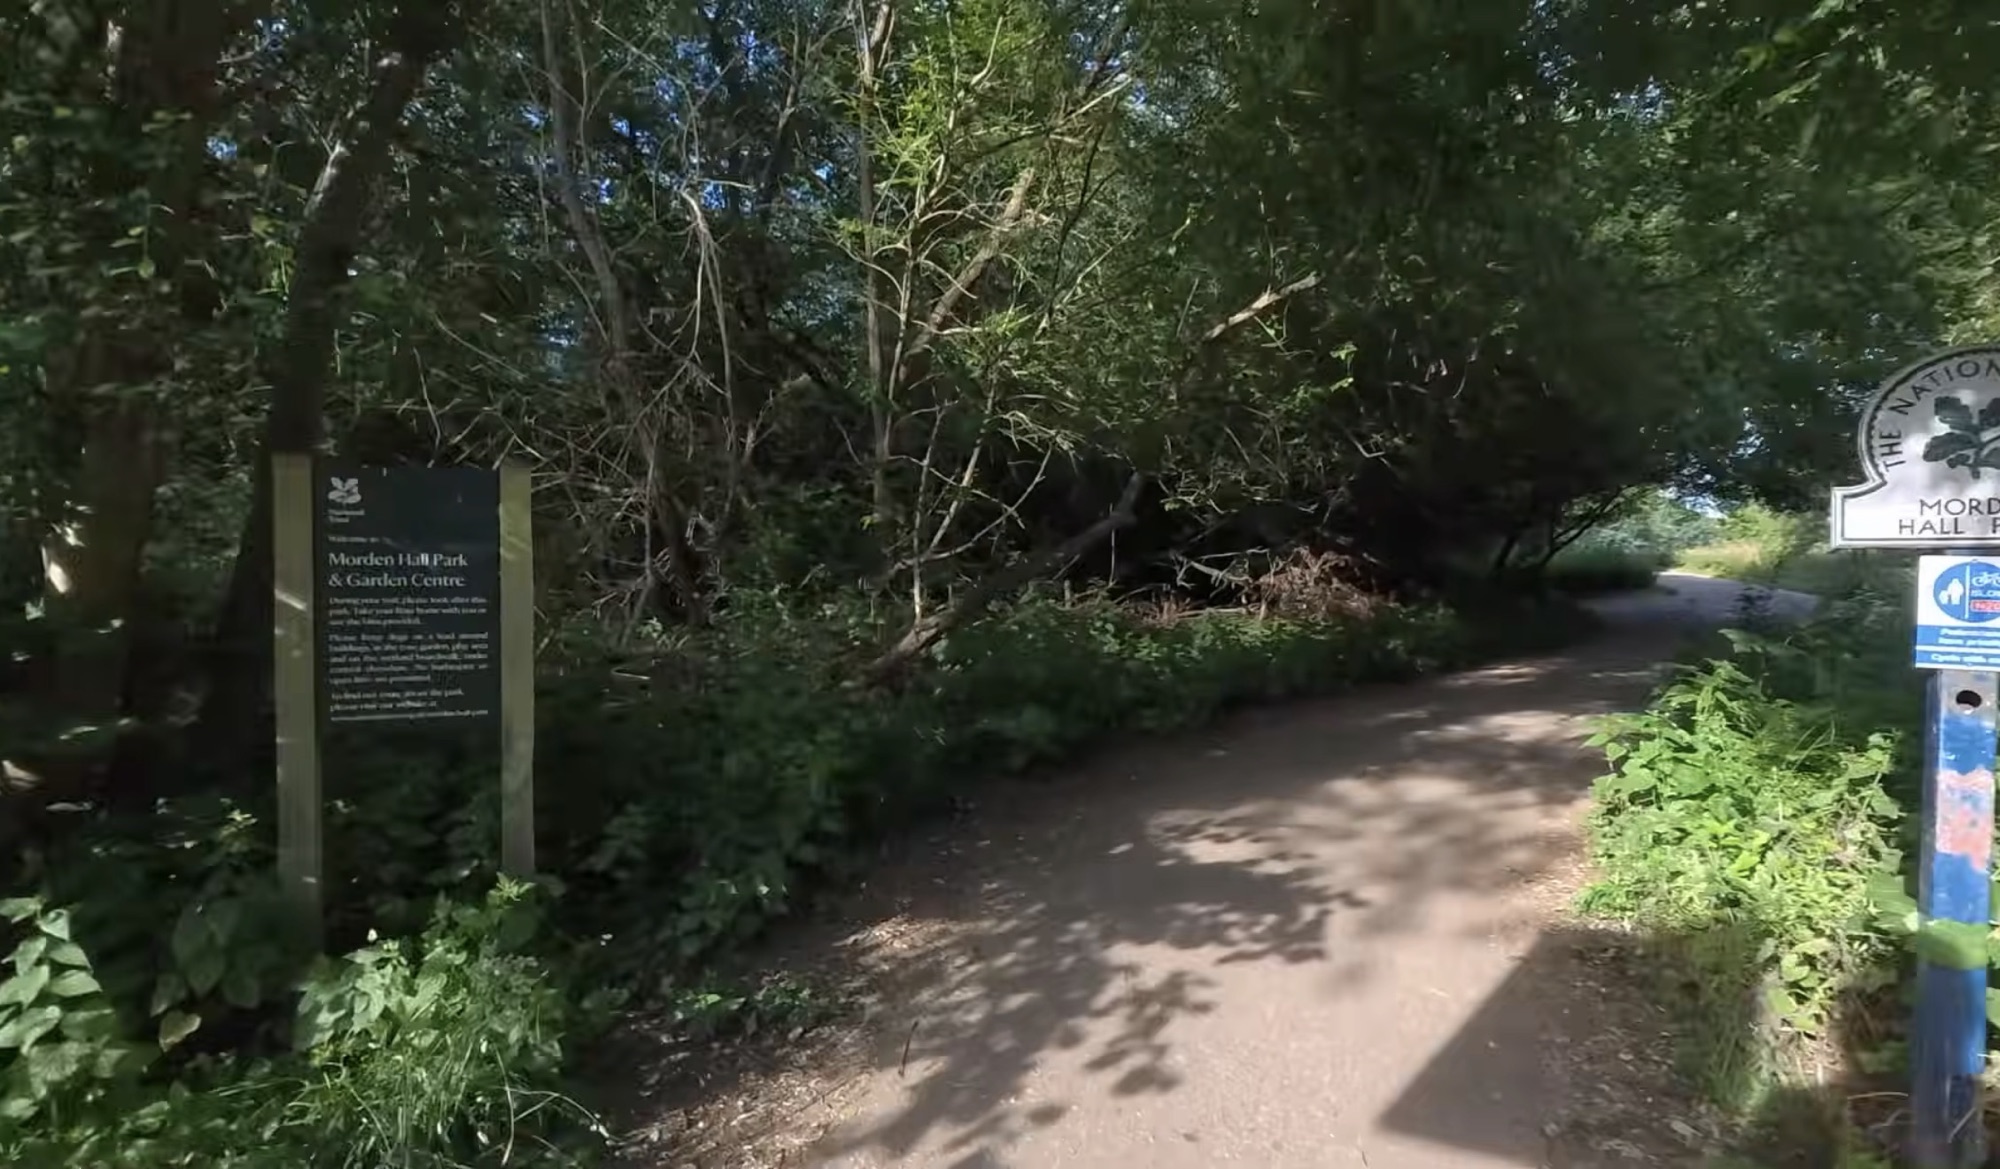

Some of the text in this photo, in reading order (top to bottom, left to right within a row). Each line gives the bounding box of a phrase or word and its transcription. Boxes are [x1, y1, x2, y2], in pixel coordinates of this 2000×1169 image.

[1879, 430, 1906, 473] THE
[1899, 517, 1965, 536] HALL
[328, 551, 468, 567] Morden Hall Park
[328, 572, 467, 587] & Garden Centre
